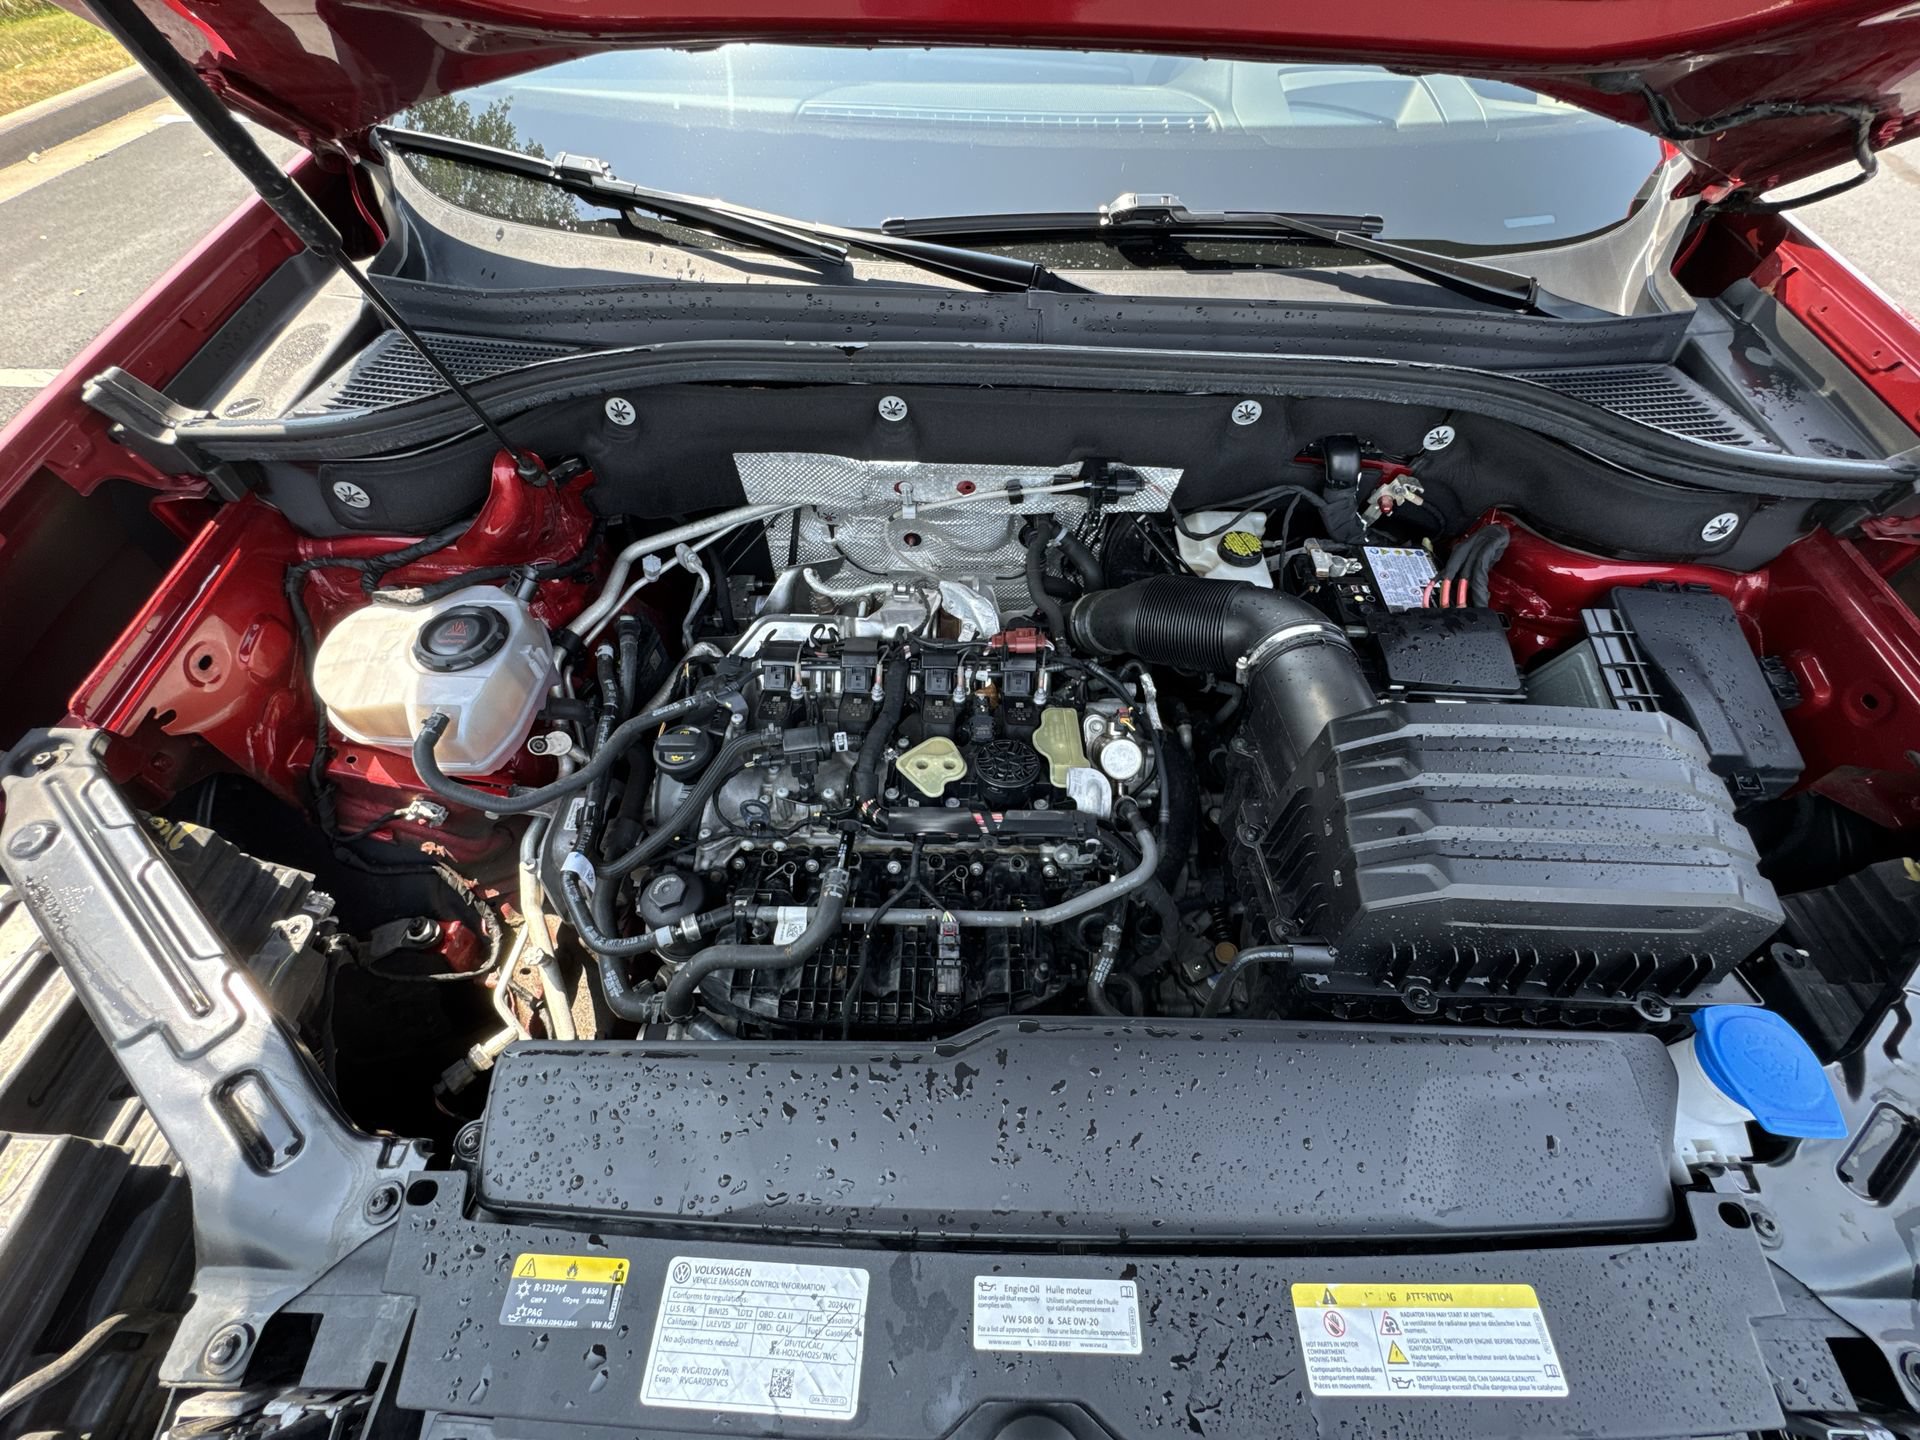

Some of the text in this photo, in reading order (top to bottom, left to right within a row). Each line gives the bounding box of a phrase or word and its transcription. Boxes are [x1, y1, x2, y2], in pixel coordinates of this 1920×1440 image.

[695, 1265, 752, 1277] VOLKSWAGEN
[534, 1283, 567, 1295] R-1234yf
[693, 1276, 826, 1291] VEHICLE EMISSION CONTROL INFORMATION
[1005, 1284, 1040, 1295] Engine Oil
[1046, 1285, 1092, 1295] Huile moteur
[673, 1291, 703, 1300] Conforms
[527, 1308, 543, 1316] PAG
[1003, 1314, 1017, 1324] VW
[1018, 1316, 1033, 1324] 508
[1034, 1316, 1045, 1325] 00
[1057, 1316, 1071, 1325] SAE
[1073, 1317, 1099, 1326] 0W-20
[776, 1324, 785, 1332] CA
[663, 1335, 673, 1343] No
[674, 1336, 714, 1345] adjustments
[657, 1364, 679, 1375] Group:
